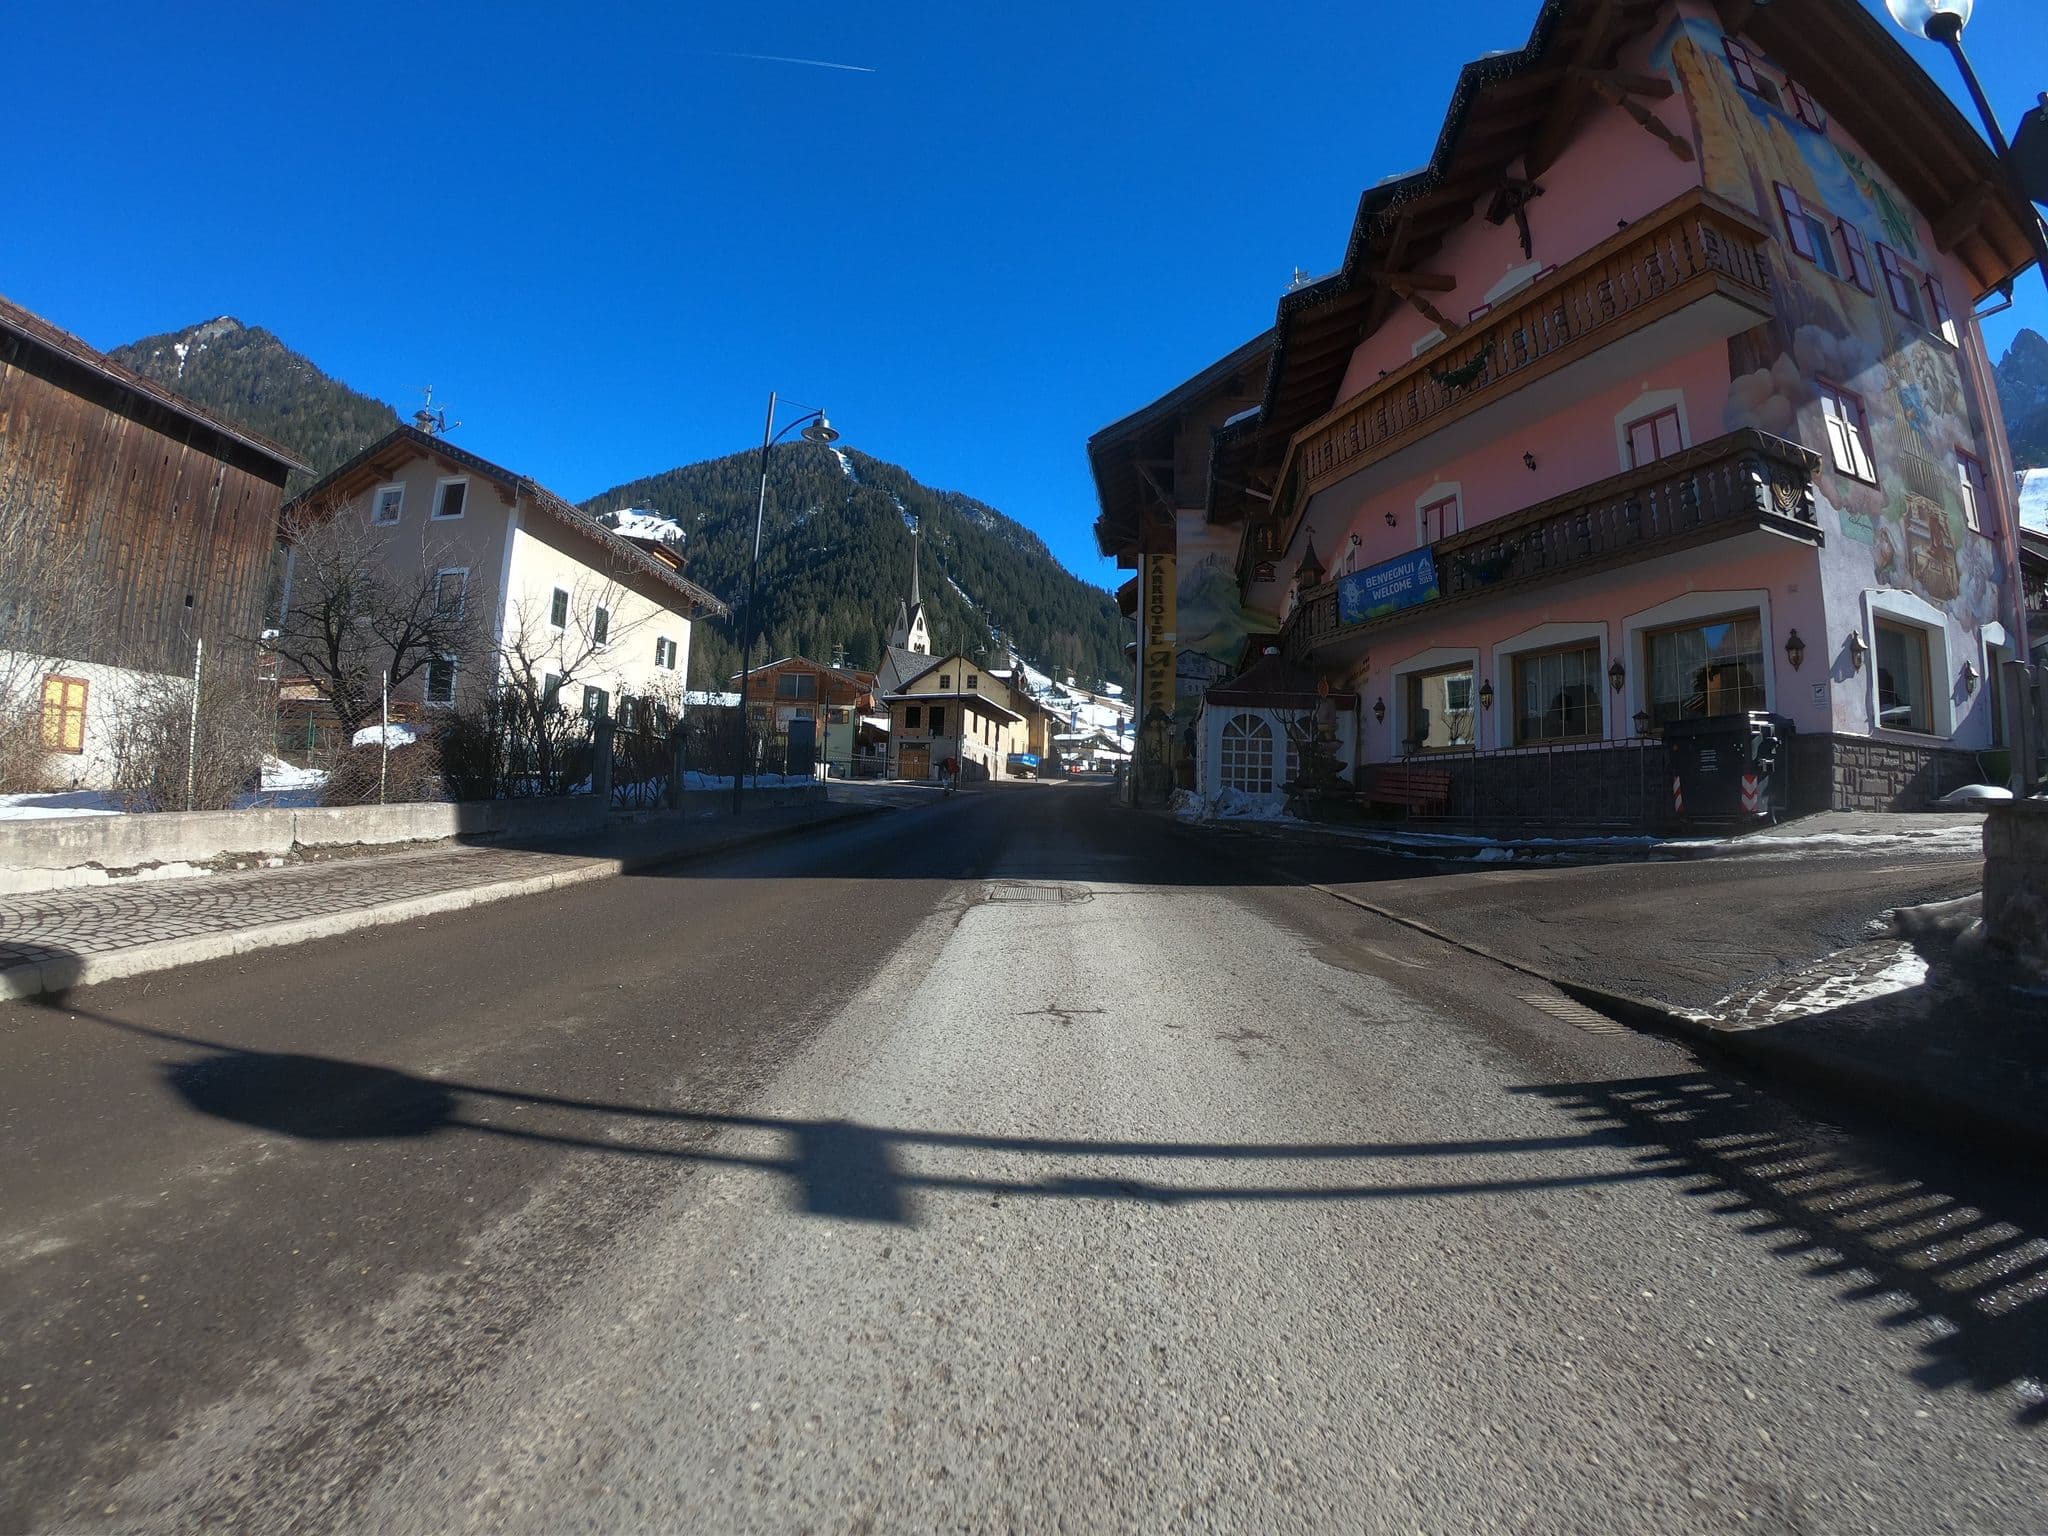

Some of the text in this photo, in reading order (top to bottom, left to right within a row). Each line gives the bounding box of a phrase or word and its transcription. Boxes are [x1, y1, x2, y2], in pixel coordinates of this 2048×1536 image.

[1366, 562, 1414, 588] BENVEGNUI
[1150, 555, 1164, 645] PARKHOTEL
[1372, 577, 1412, 600] WELCOME
